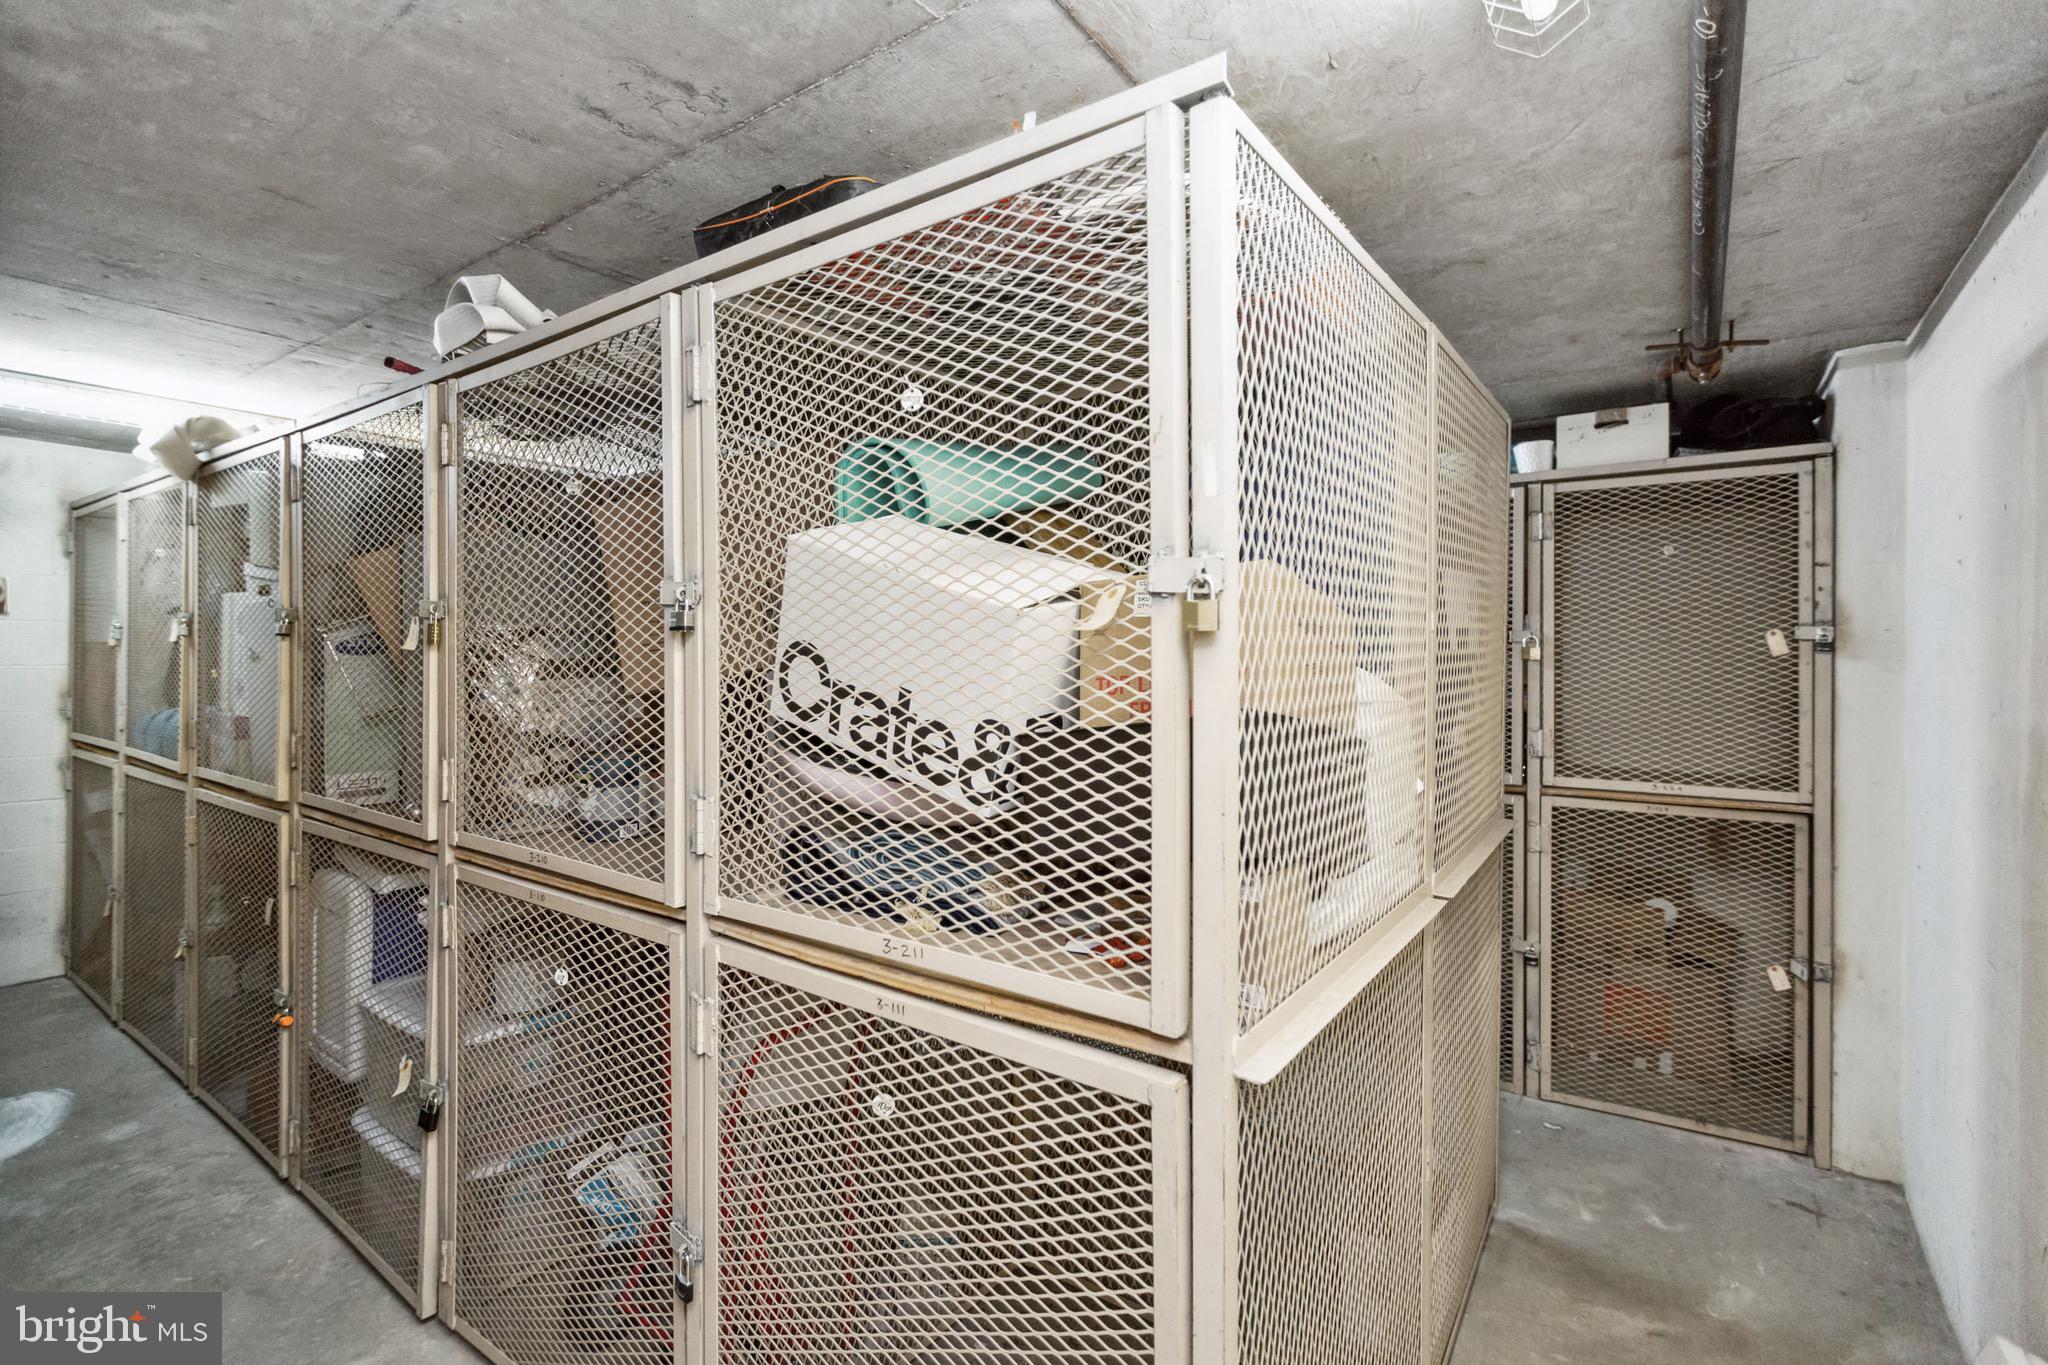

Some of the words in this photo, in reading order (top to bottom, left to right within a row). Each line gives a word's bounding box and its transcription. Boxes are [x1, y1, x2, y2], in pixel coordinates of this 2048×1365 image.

[529, 851, 548, 865] 3-210
[883, 938, 924, 960] 3-211
[875, 997, 905, 1016] 3-111
